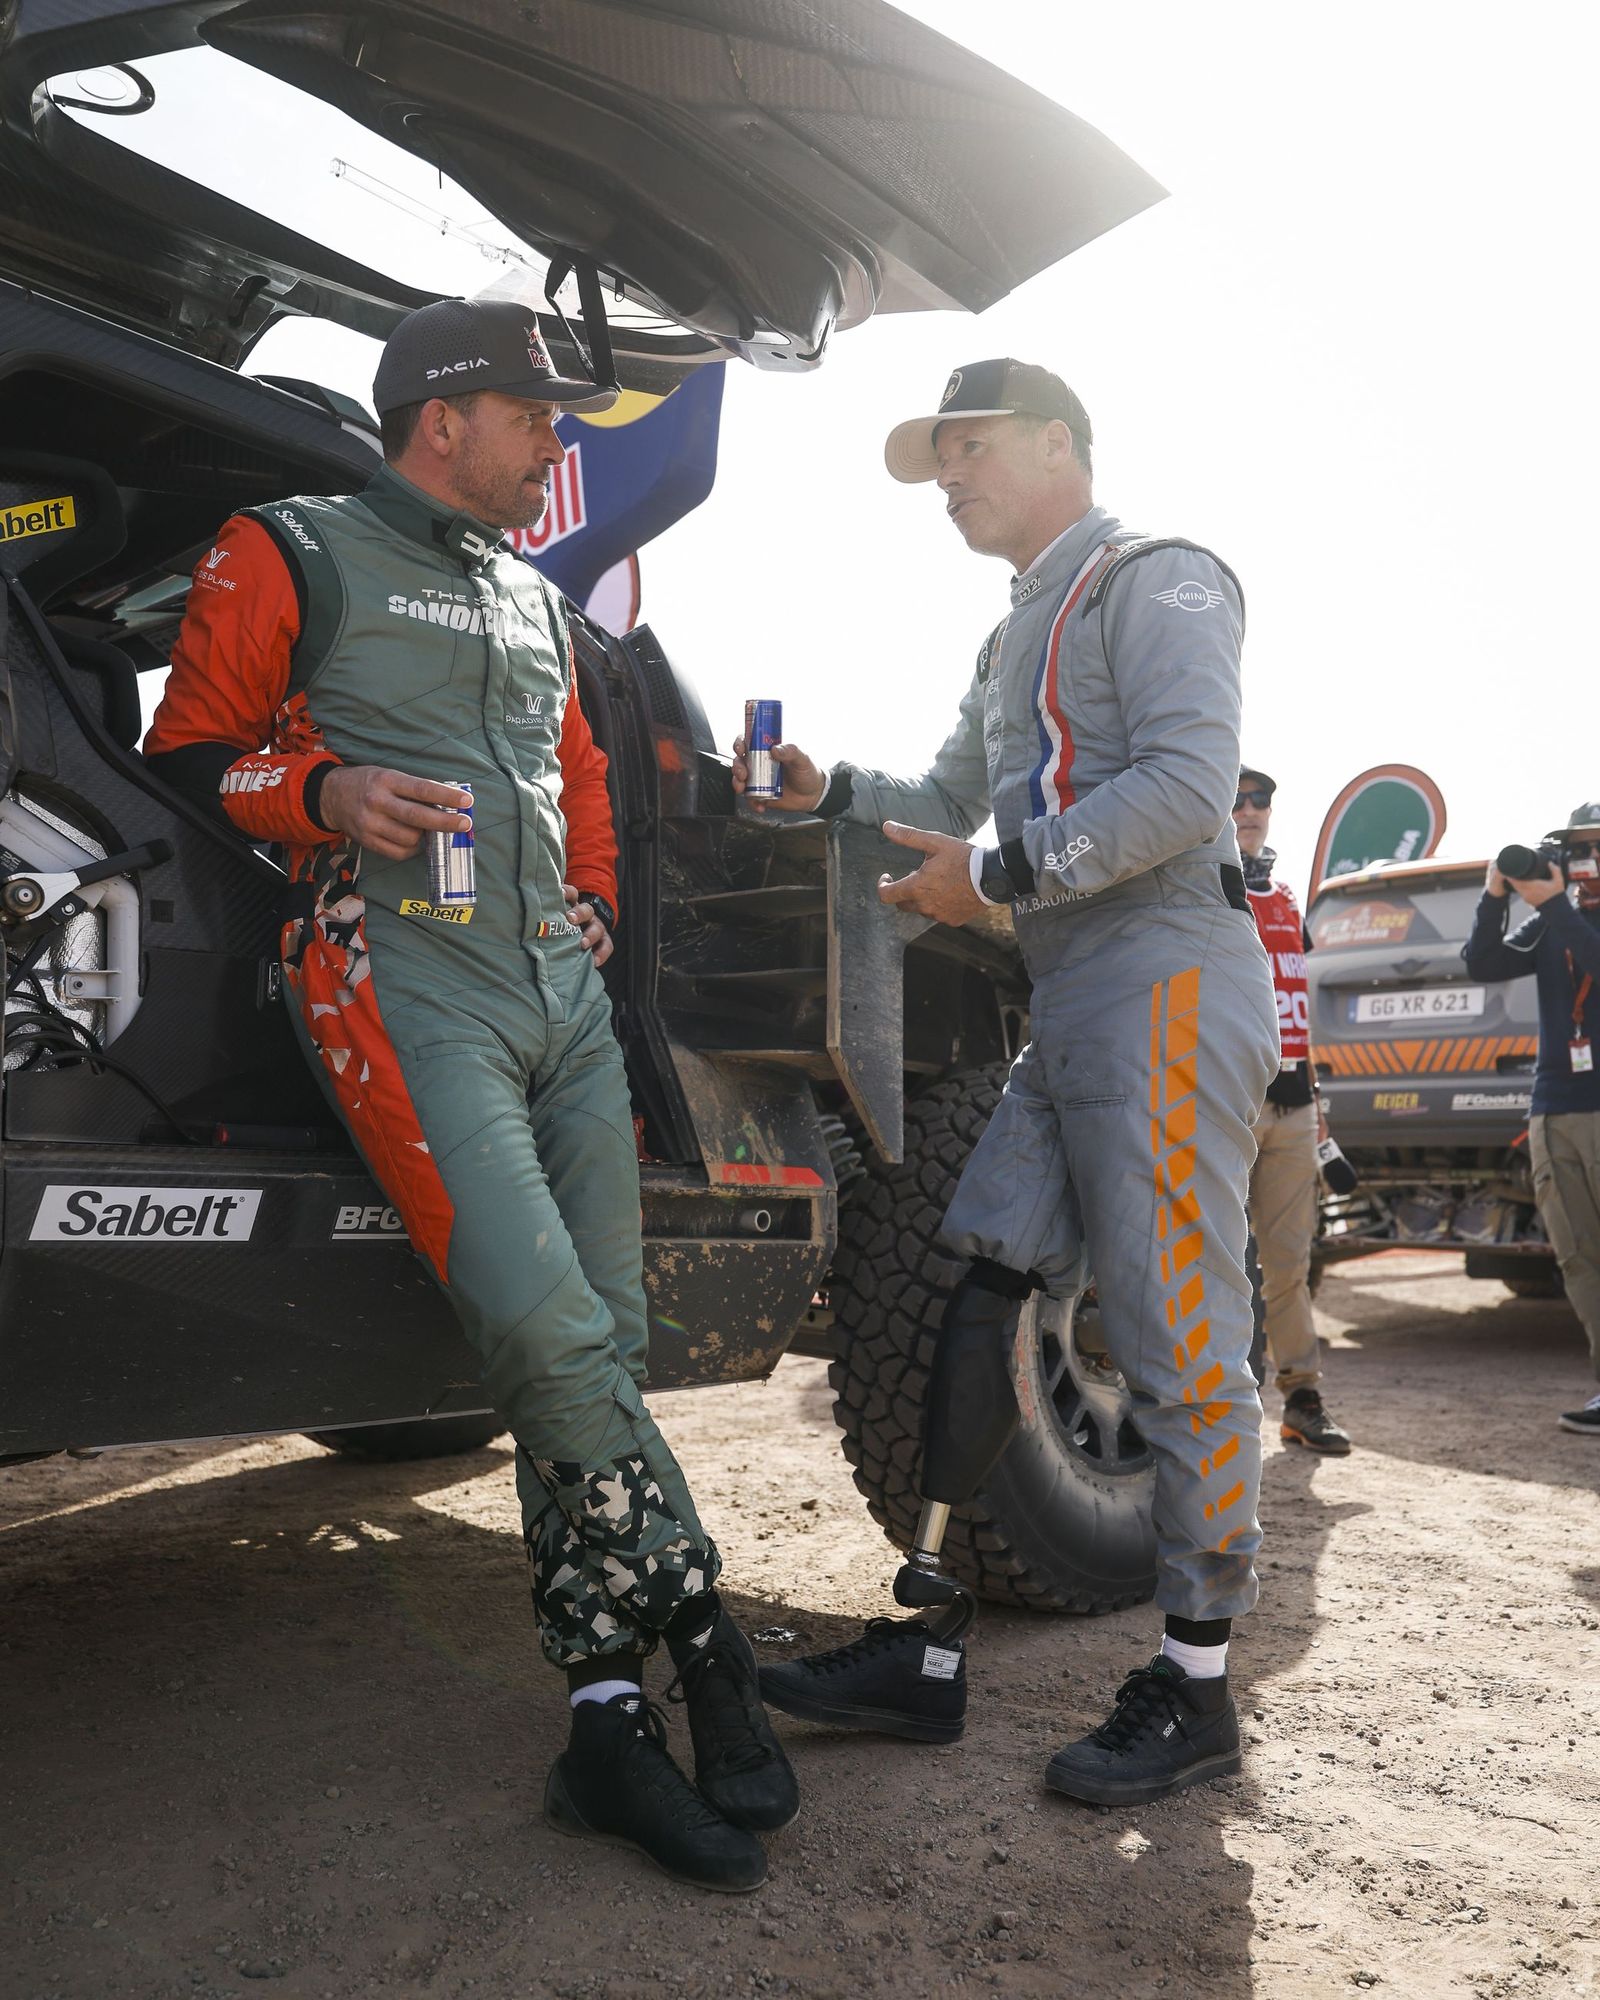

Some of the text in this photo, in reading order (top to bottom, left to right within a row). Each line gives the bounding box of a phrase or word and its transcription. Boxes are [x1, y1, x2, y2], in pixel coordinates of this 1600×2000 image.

[426, 357, 490, 380] DACIA
[275, 510, 320, 553] Sabelt
[207, 573, 237, 591] PLAGE
[421, 588, 467, 603] THE
[1179, 591, 1207, 602] MINI
[407, 901, 465, 922] Sabelt
[1371, 993, 1469, 1016] GG XR 621
[58, 1190, 238, 1237] Sabelt
